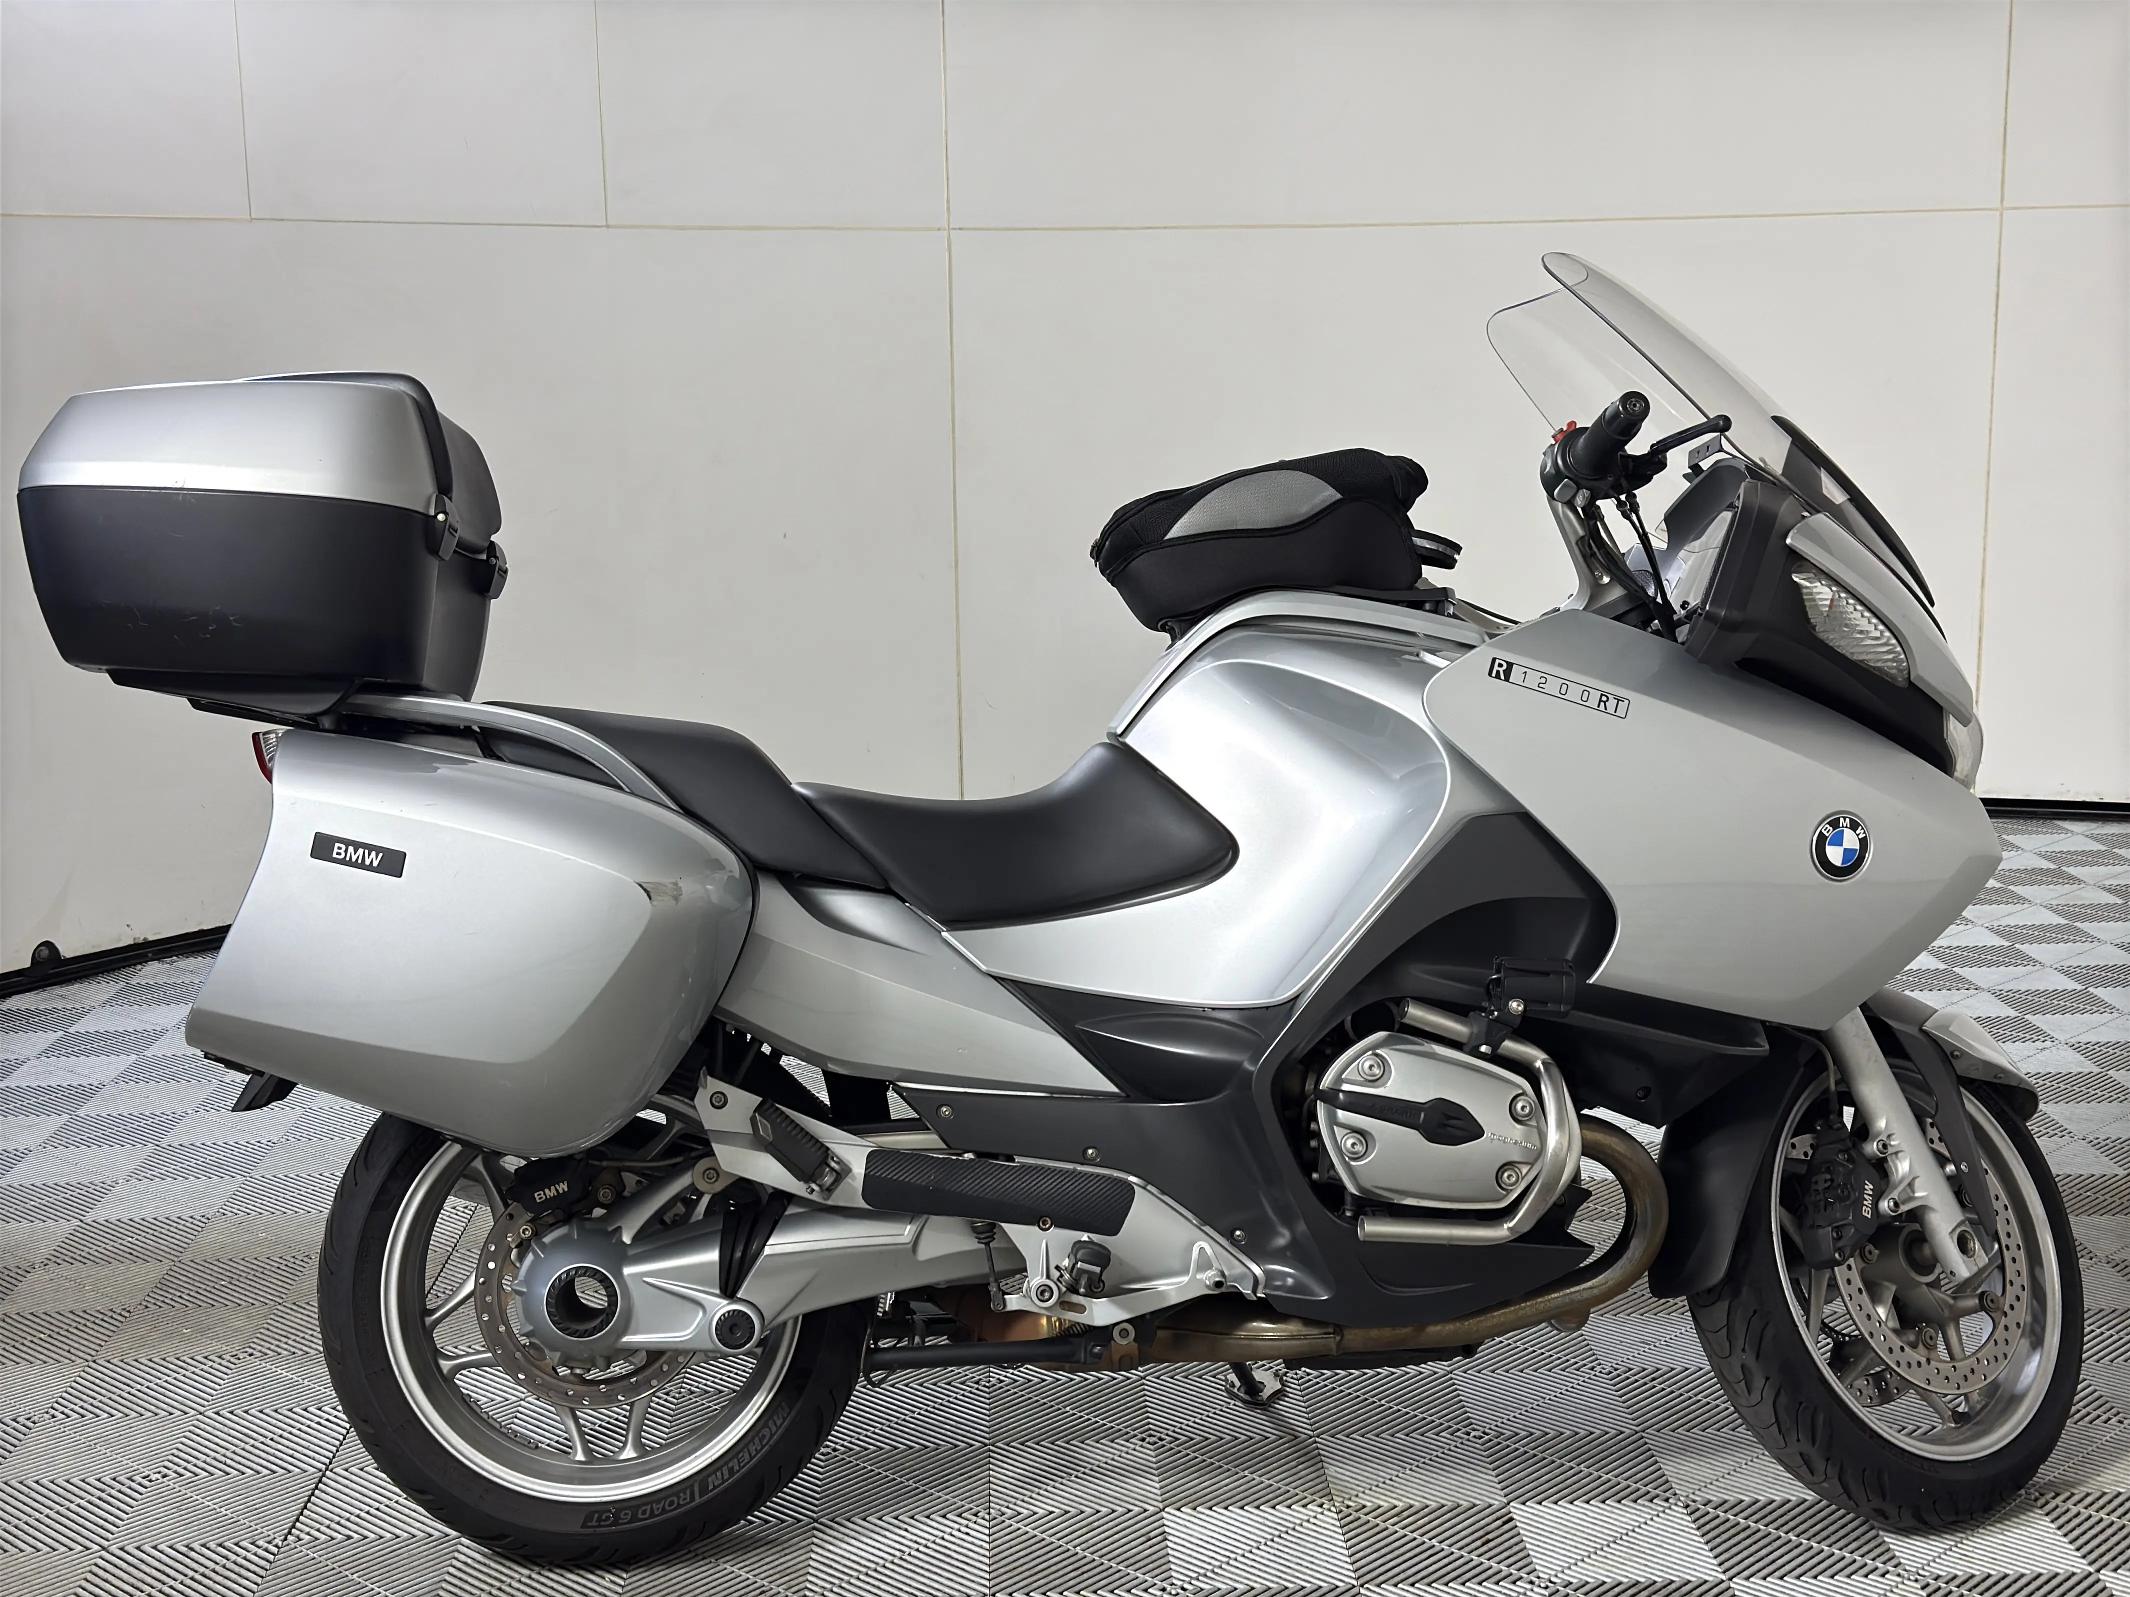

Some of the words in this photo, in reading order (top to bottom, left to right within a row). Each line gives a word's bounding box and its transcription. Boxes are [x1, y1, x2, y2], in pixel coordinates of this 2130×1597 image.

[1821, 817, 1866, 839] BMW
[332, 842, 384, 868] BMW
[534, 1180, 569, 1203] BMW
[1861, 1180, 1875, 1219] BMW
[708, 1402, 791, 1492] MICHELIN
[637, 1488, 690, 1518] ROAD
[588, 1512, 614, 1526] GT
[619, 1510, 633, 1524] 6
